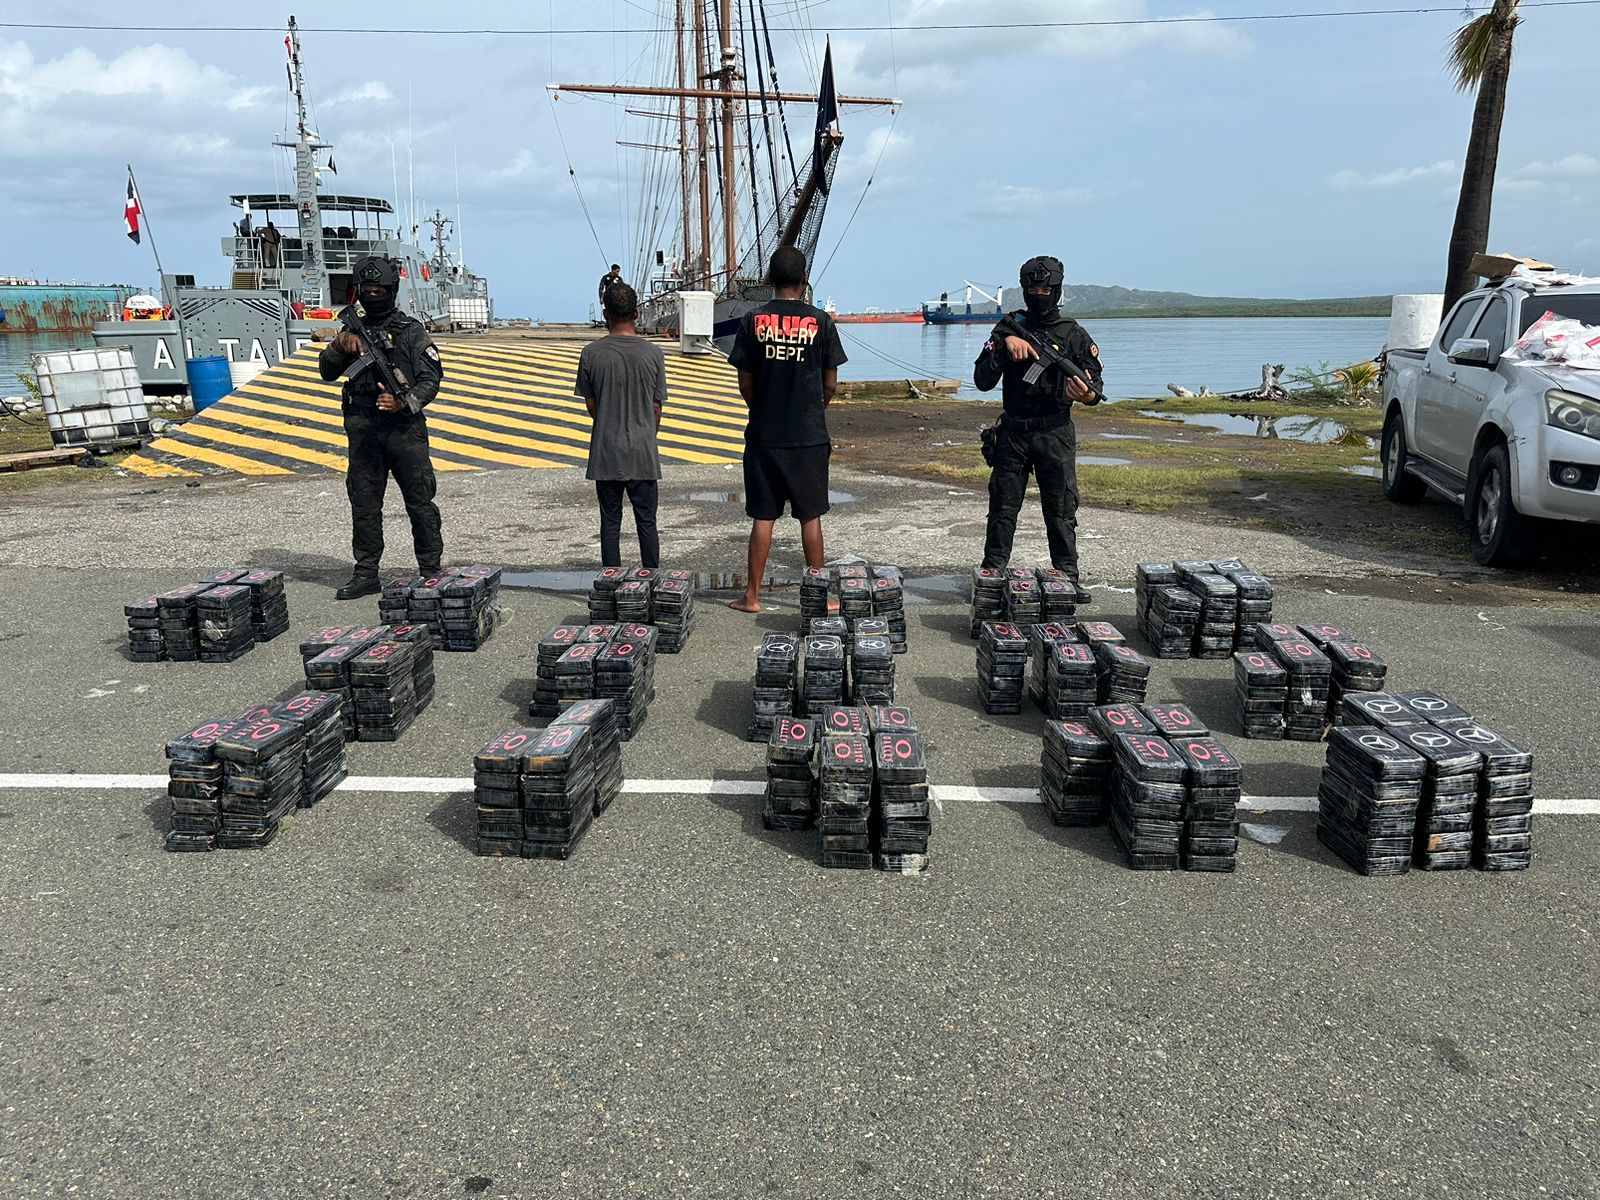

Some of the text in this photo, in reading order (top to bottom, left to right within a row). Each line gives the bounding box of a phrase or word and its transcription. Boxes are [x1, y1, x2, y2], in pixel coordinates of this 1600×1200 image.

[754, 313, 818, 336] PLUG
[756, 325, 818, 345] GALLERY
[765, 344, 804, 361] DEPT.
